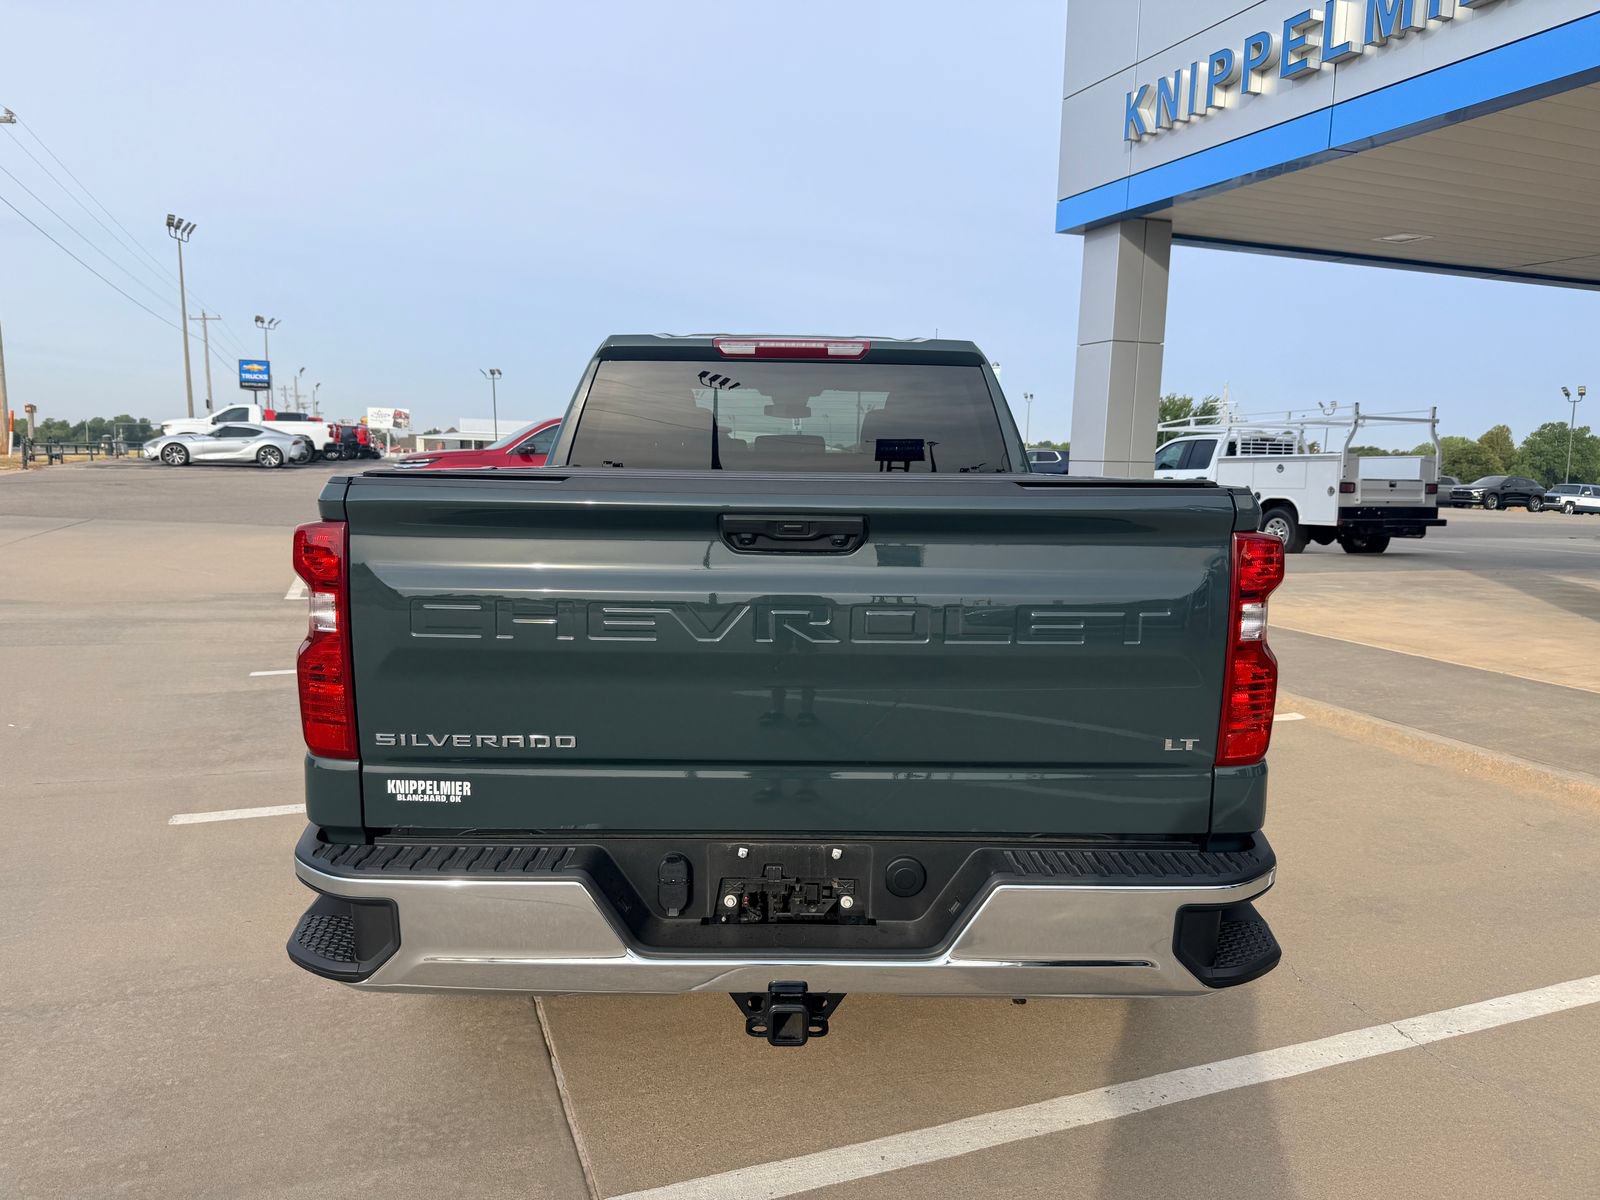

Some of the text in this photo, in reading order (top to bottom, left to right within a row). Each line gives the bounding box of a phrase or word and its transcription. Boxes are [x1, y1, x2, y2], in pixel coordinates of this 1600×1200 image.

[1124, 0, 1490, 141] KNIPPELM
[410, 599, 1174, 645] CHEVROLET
[375, 733, 576, 748] SILVERADO
[1164, 738, 1200, 751] LT
[387, 779, 471, 796] KNIPPELMIER
[396, 794, 462, 803] BLANCHARD, OK
